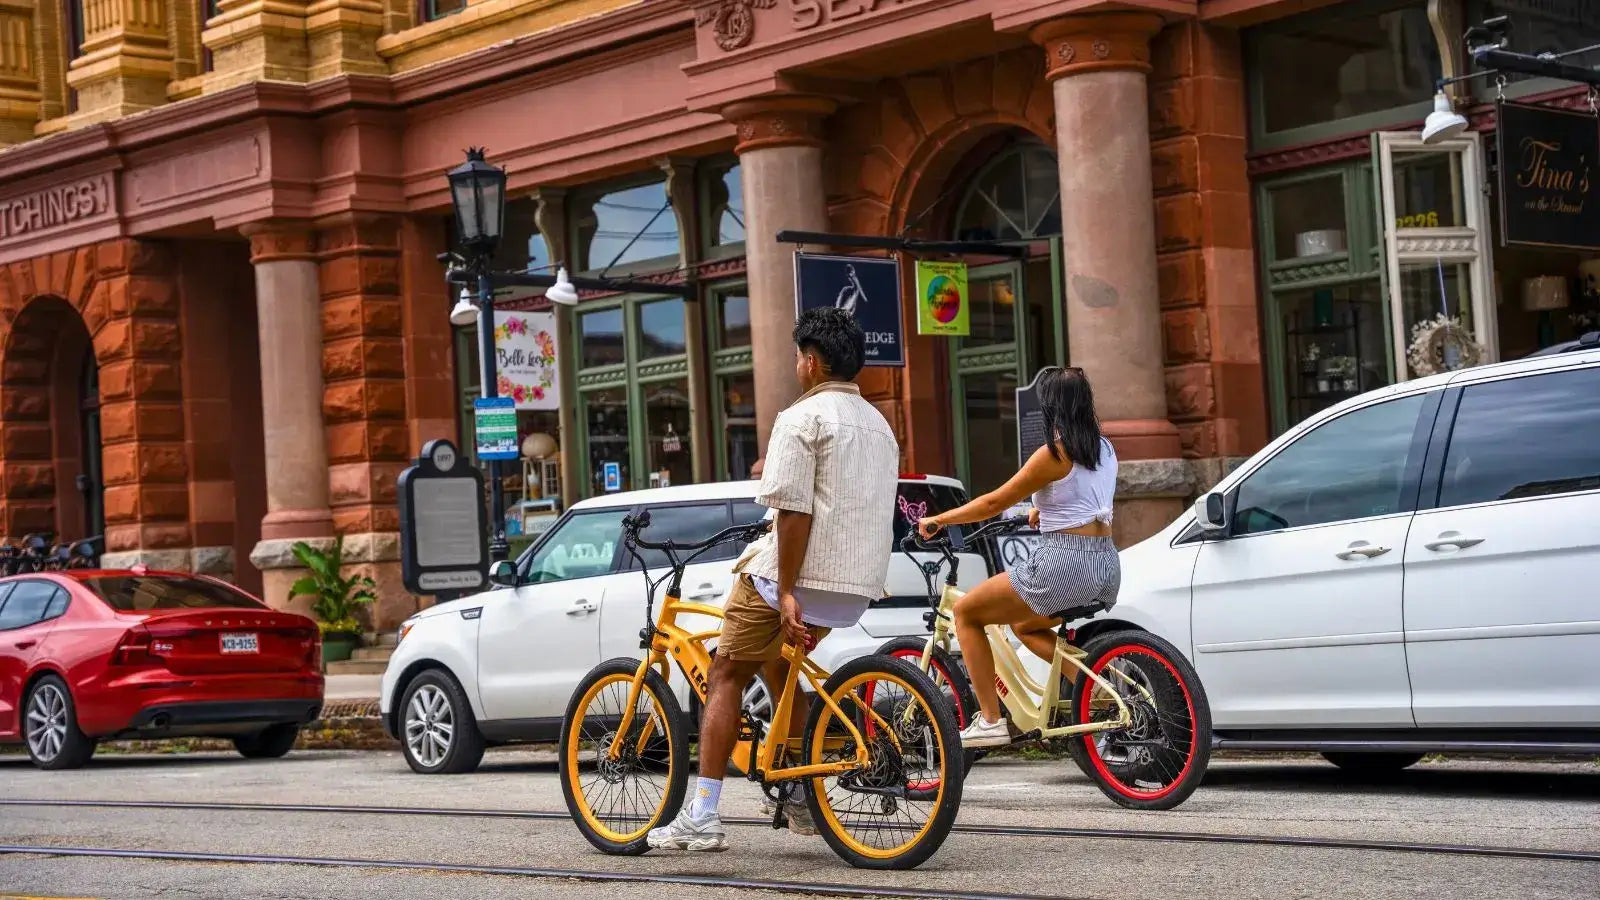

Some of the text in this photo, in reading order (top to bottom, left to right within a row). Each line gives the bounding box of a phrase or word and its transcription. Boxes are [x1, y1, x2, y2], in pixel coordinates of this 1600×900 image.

[1517, 136, 1589, 193] Tina's
[1537, 196, 1549, 210] the
[864, 331, 896, 344] EDGE
[499, 348, 525, 368] Belle
